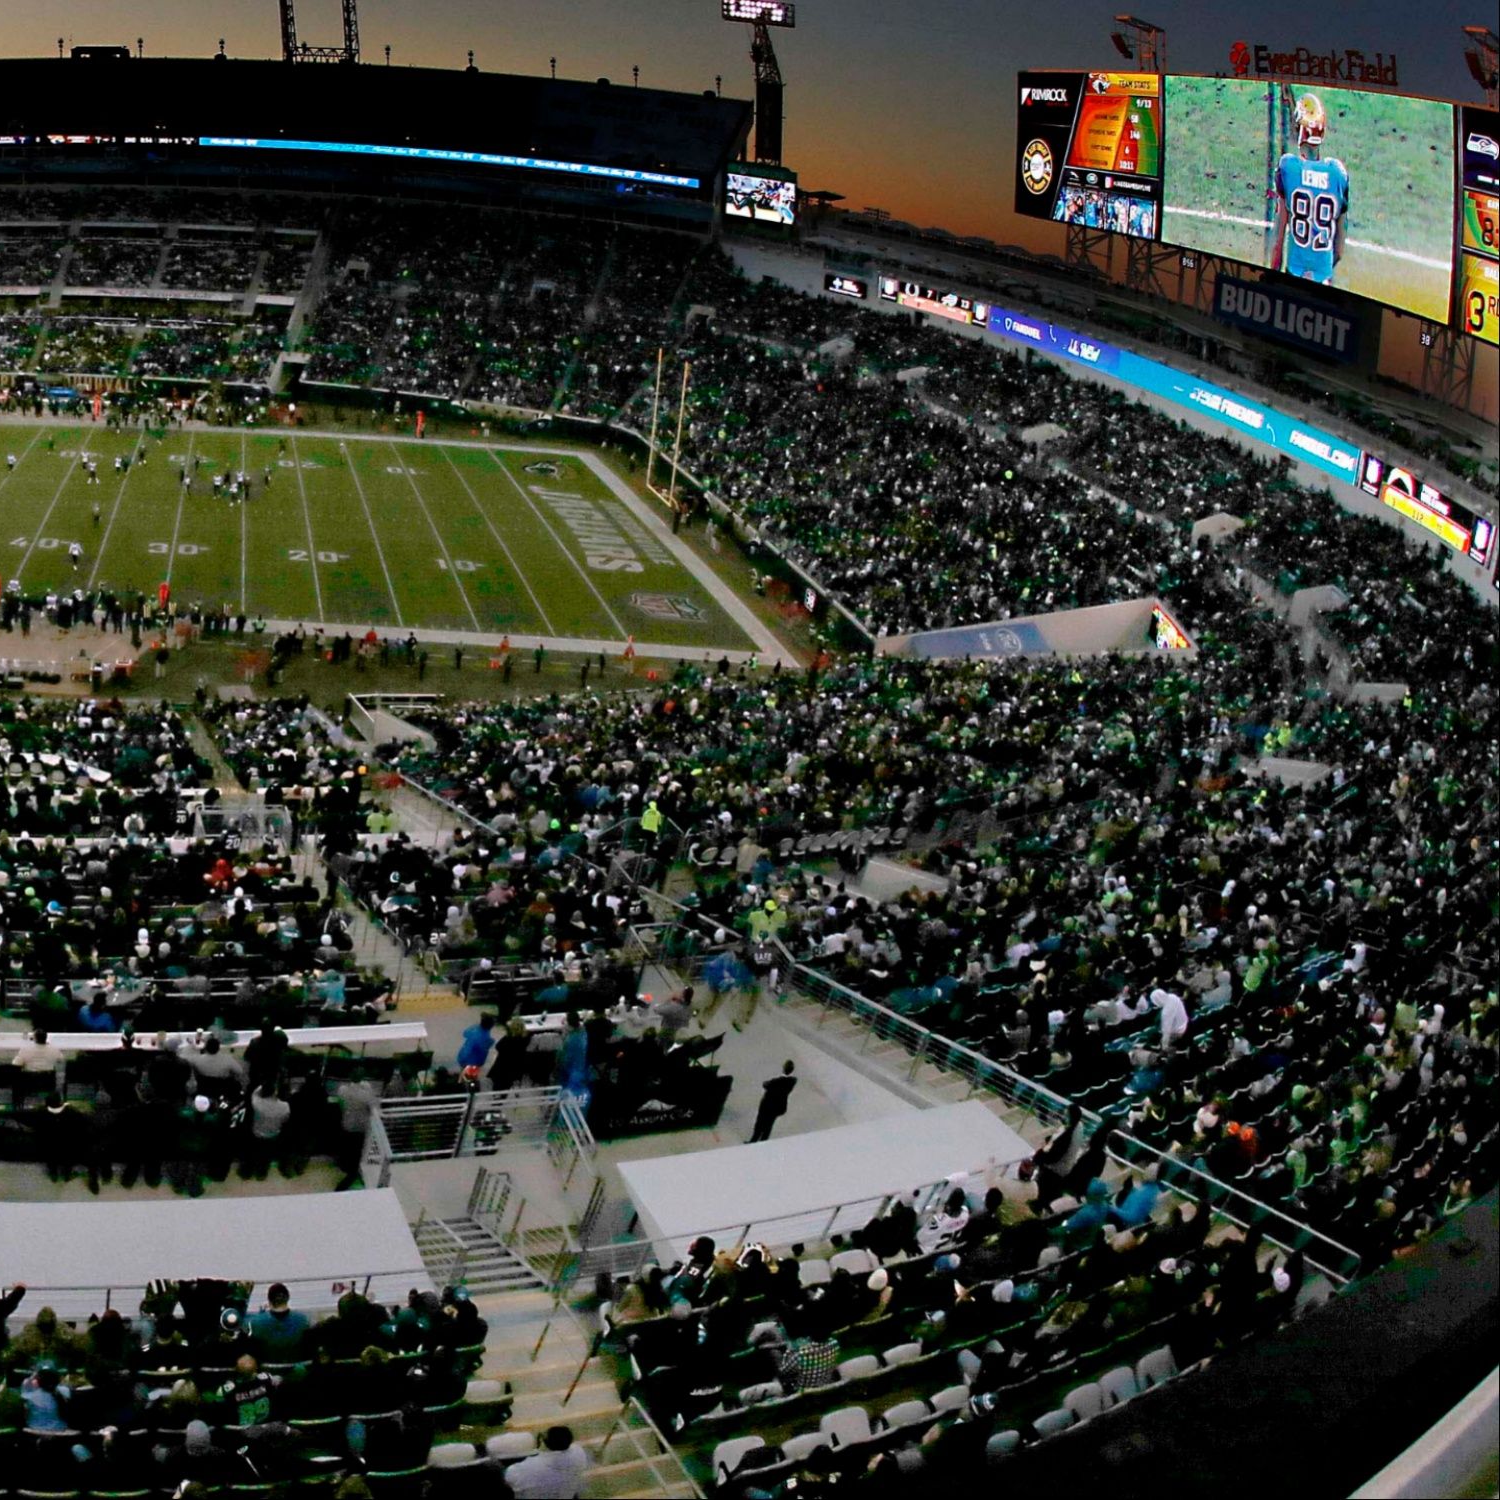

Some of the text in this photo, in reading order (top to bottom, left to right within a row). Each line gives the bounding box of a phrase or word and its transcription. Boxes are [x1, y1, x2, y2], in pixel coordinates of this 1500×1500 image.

[1253, 45, 1398, 86] EverBank Field
[1031, 88, 1068, 102] RIMROCK
[1301, 169, 1329, 190] LEWIS
[1290, 188, 1337, 251] 89
[1220, 283, 1351, 352] BUD LIGHT
[9, 536, 60, 549] 40
[147, 542, 199, 555] 30
[287, 549, 339, 562] 20
[436, 558, 476, 571] 10
[225, 838, 241, 850] 20
